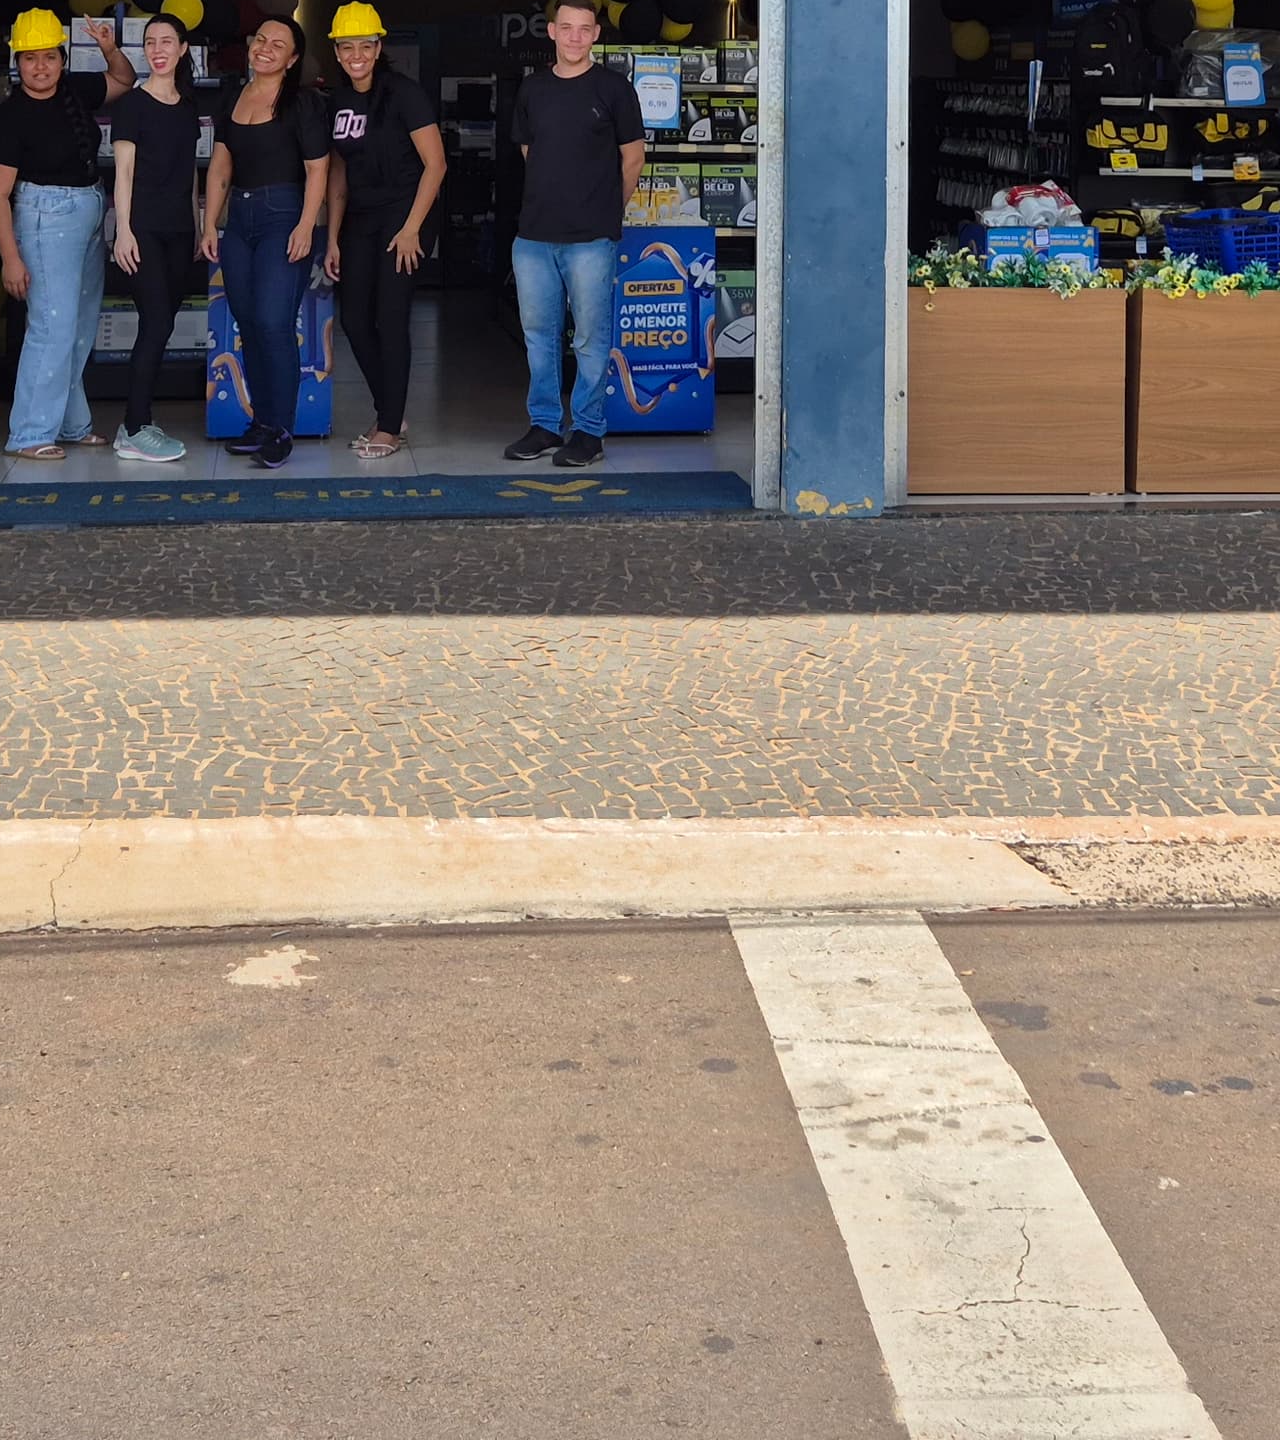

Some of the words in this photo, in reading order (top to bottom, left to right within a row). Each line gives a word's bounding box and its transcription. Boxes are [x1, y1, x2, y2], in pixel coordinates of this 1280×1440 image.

[703, 183, 716, 192] DE
[716, 183, 735, 192] LED
[628, 282, 676, 293] OFERTAS
[620, 302, 687, 315] APROVEITE
[620, 317, 632, 329] O
[634, 315, 687, 328] MENOR
[621, 329, 688, 350] PREÇO
